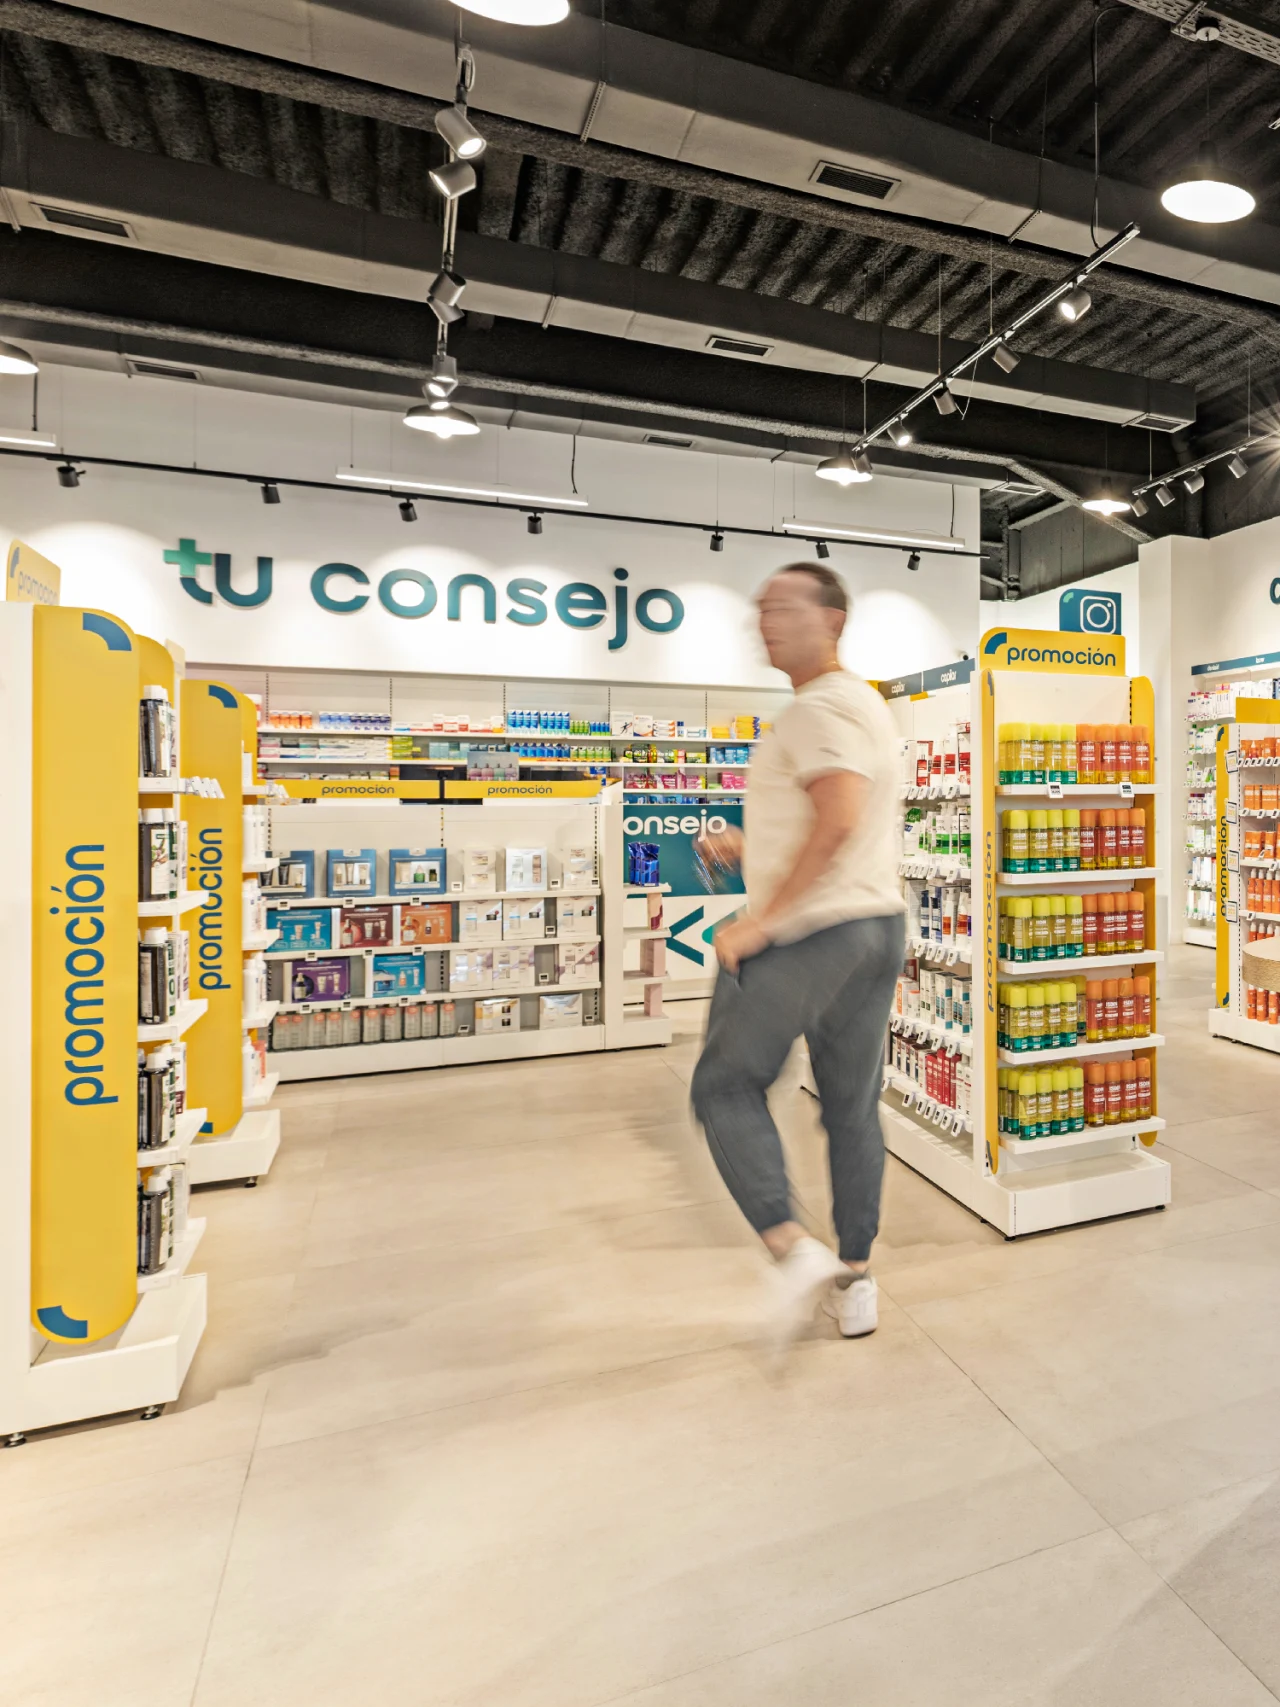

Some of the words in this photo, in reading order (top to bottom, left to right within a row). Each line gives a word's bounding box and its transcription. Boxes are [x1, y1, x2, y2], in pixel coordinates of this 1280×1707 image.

[163, 538, 274, 608] tu
[310, 561, 686, 651] consejo
[1007, 646, 1116, 667] promoción
[321, 783, 395, 796] promoción
[487, 784, 553, 796] promoción
[623, 808, 728, 842] onsejo
[189, 828, 232, 991] promoción
[49, 844, 119, 1107] promoción
